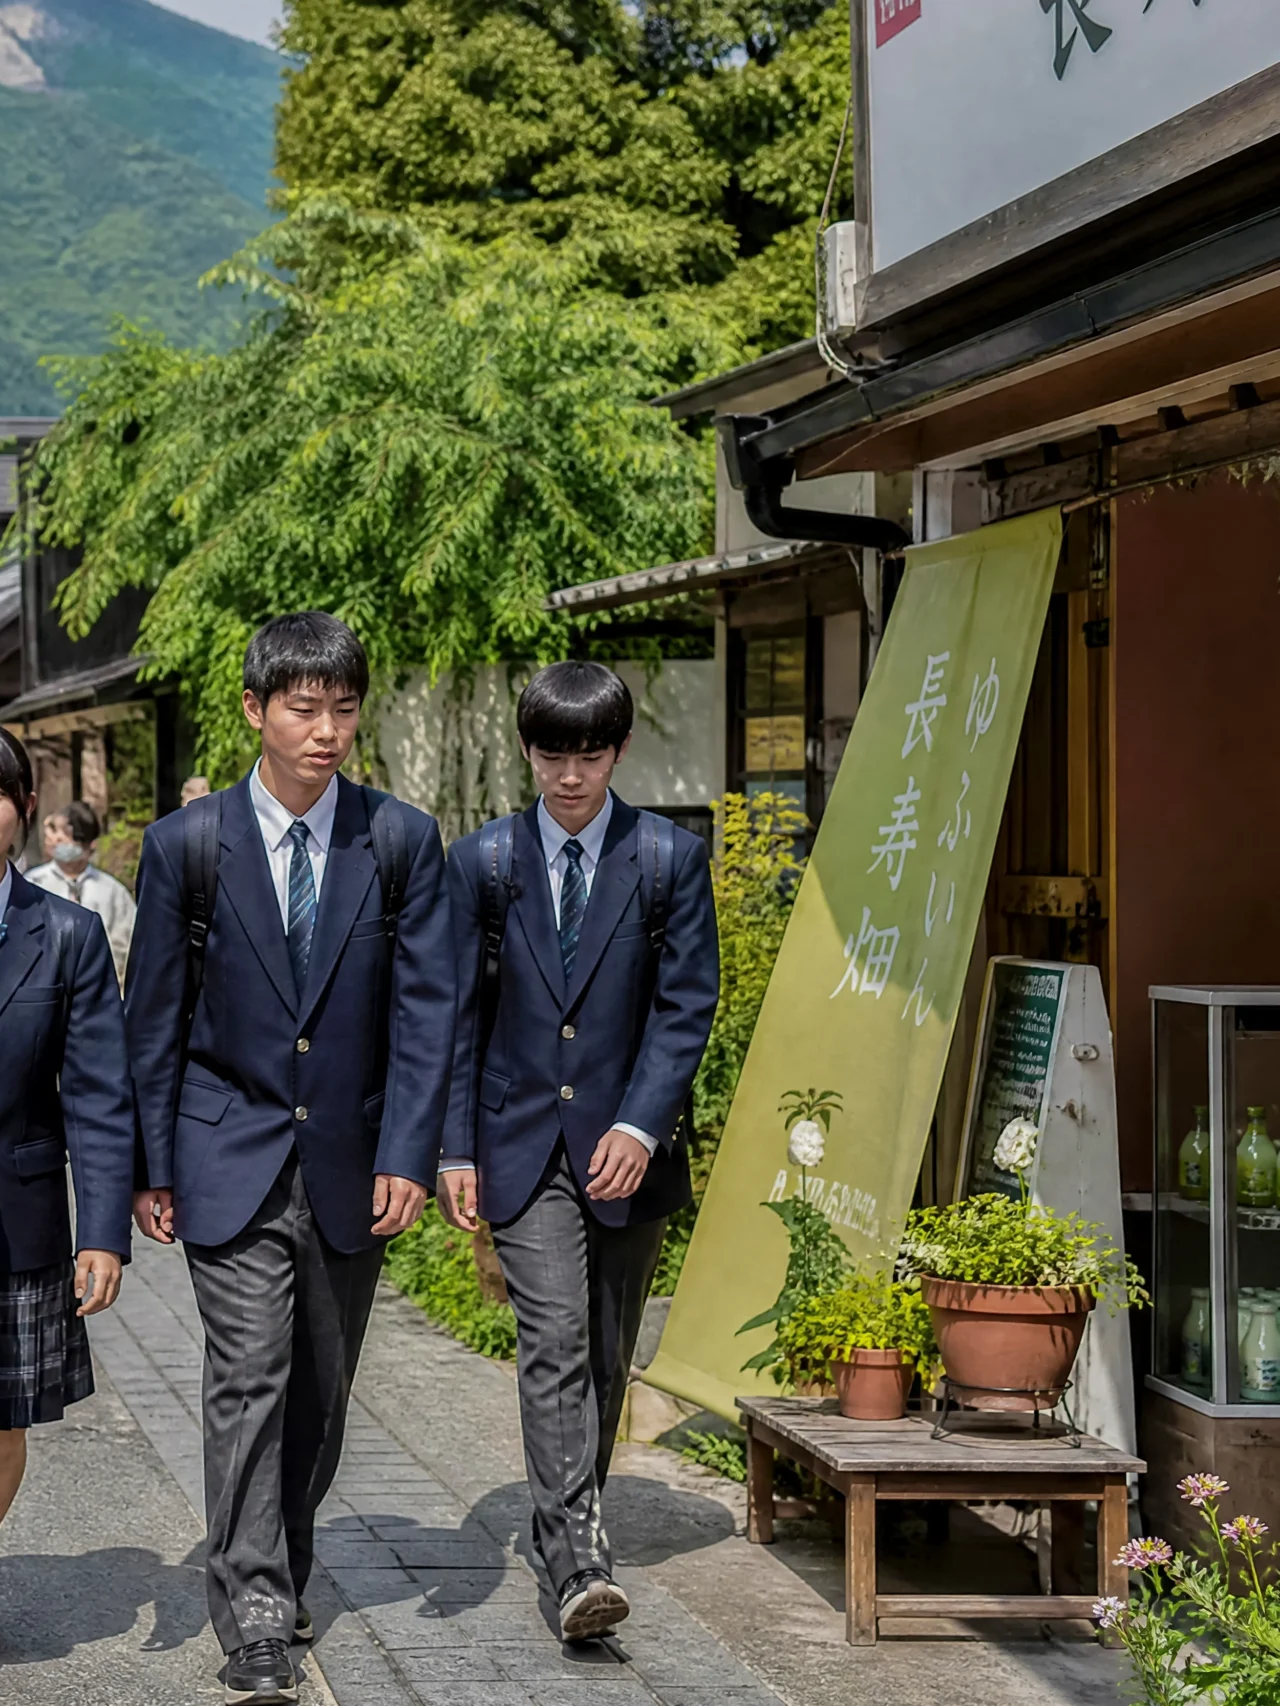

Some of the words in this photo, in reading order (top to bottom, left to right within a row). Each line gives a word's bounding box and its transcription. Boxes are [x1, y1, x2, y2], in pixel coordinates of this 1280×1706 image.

[829, 650, 950, 1000] 長寿畑
[900, 656, 1000, 1027] ゆふいん
